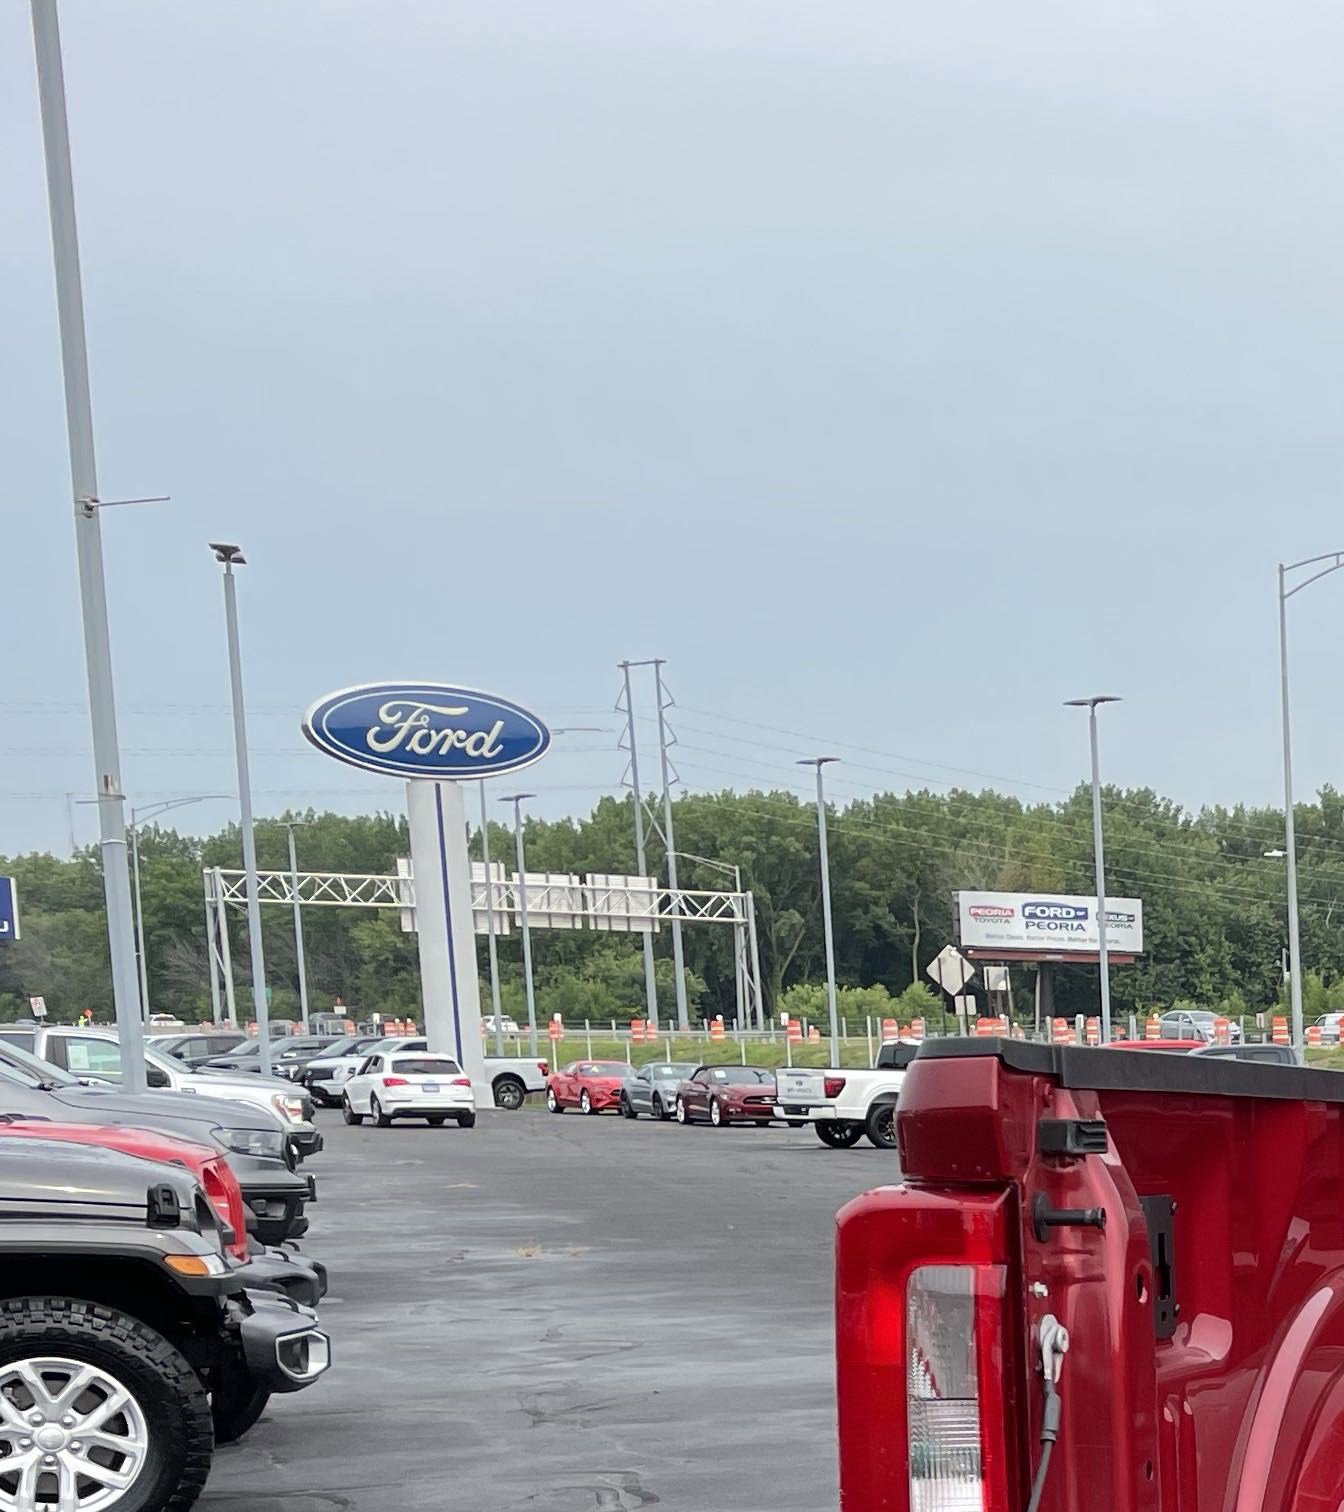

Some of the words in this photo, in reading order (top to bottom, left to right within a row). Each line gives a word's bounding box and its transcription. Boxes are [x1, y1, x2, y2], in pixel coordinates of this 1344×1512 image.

[366, 700, 505, 758] Ford
[969, 906, 1013, 916] PEORIA
[1023, 905, 1076, 918] FORD
[974, 917, 1012, 925] TOYOTA
[1024, 920, 1087, 932] PEORIA
